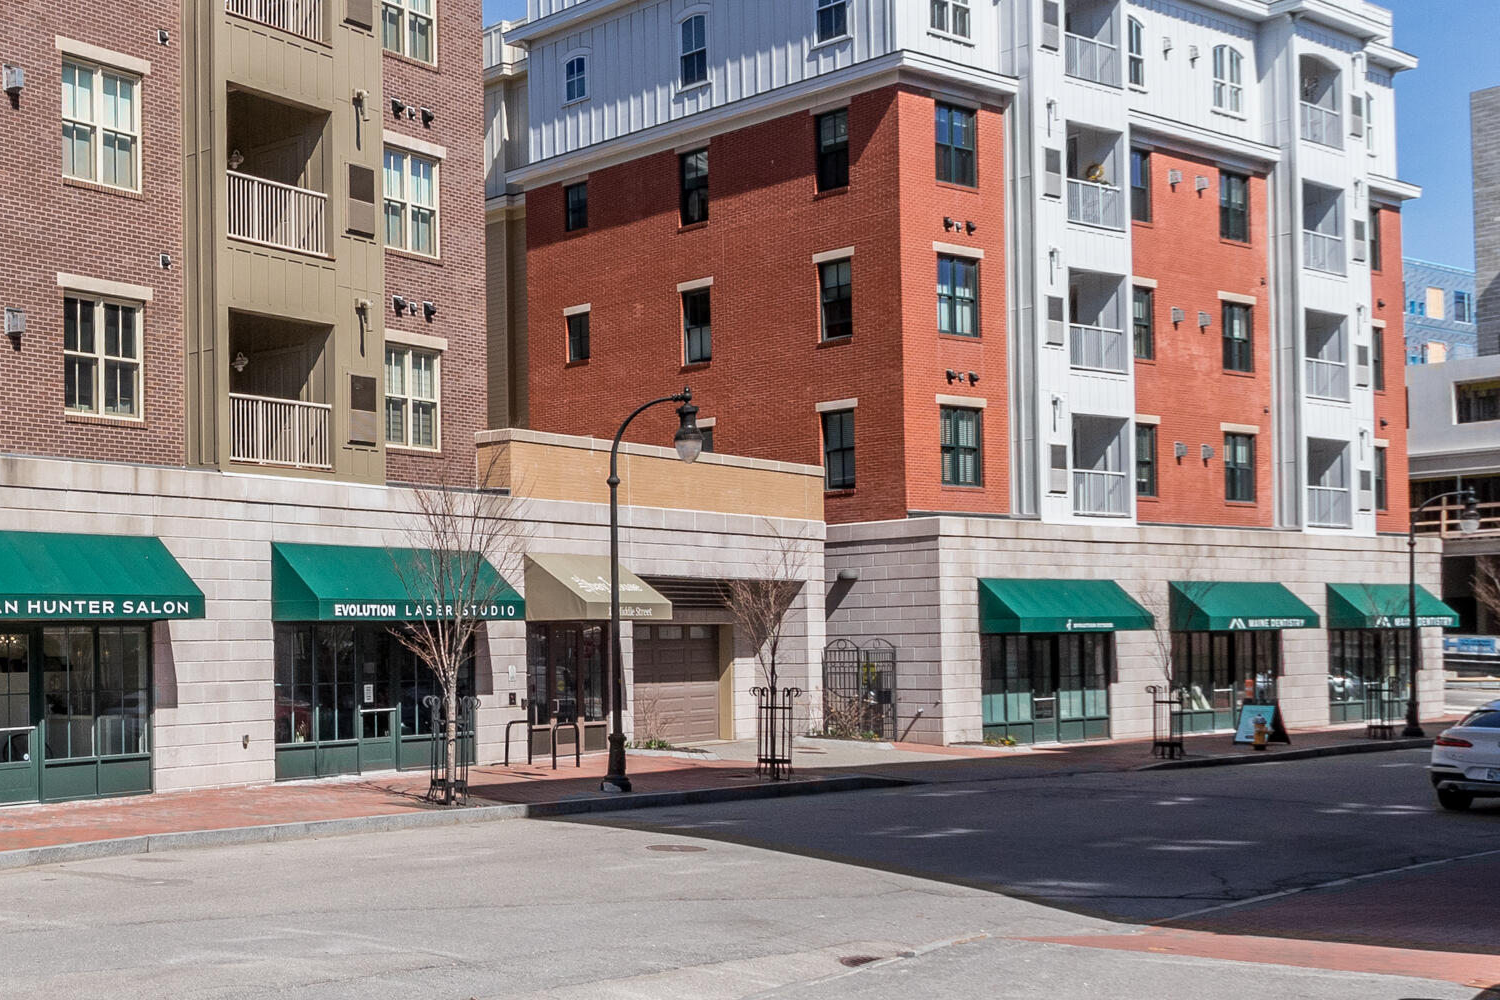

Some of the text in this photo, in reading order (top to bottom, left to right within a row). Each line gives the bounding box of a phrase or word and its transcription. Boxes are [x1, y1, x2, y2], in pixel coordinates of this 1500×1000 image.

[27, 600, 115, 614] HUNTER
[122, 601, 189, 614] SALON
[334, 604, 515, 617] EVOLUTION LASER STUDIO
[635, 607, 652, 617] Street
